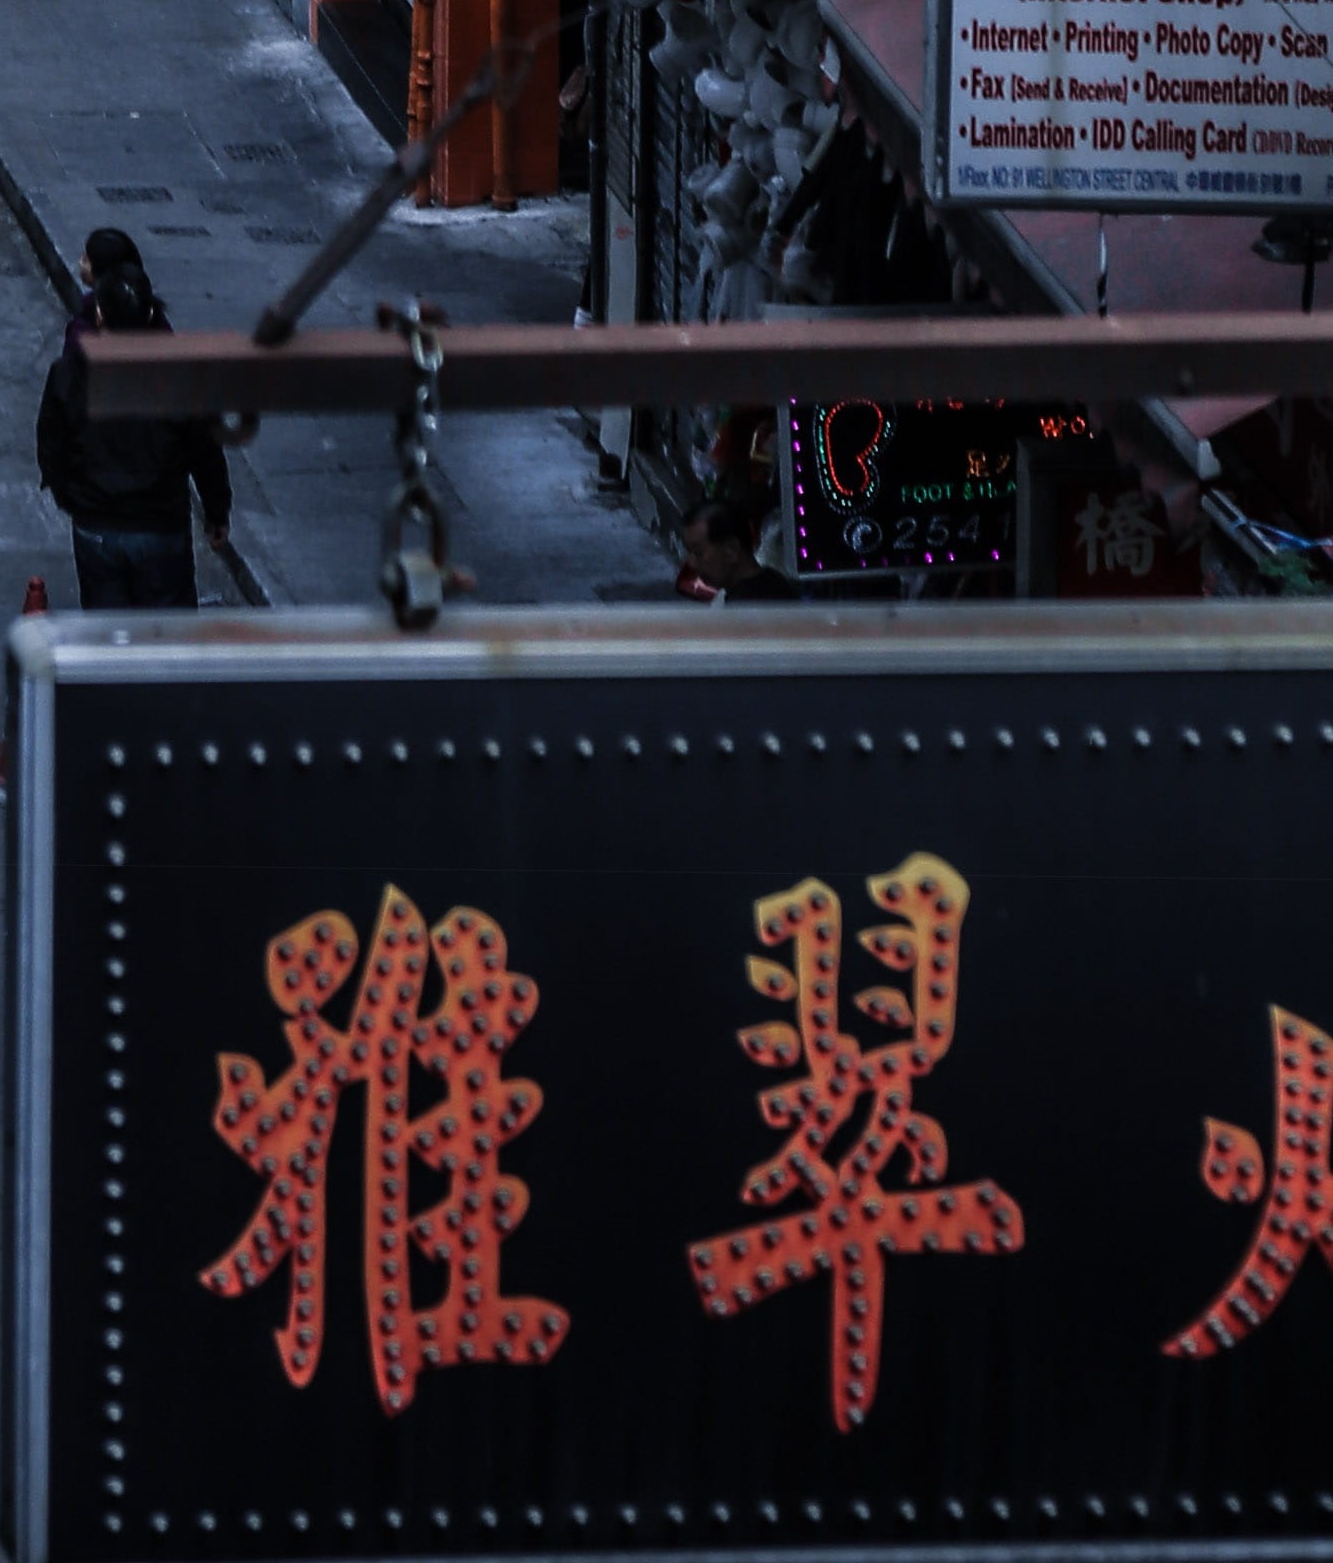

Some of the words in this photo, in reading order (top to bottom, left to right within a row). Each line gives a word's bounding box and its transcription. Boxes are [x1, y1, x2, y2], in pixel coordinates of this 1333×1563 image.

[971, 19, 1048, 53] Internet
[1065, 20, 1138, 62] Printing
[1155, 20, 1211, 55] Photo
[1216, 23, 1263, 65] Copy
[1281, 25, 1328, 59] Scan
[971, 68, 1004, 101] Fax
[1054, 77, 1064, 100] &
[1144, 70, 1289, 107] Documentation
[969, 116, 1075, 150] Lamination
[1092, 118, 1125, 150] IDD
[1132, 119, 1196, 160] Calling
[1202, 121, 1247, 153] Card
